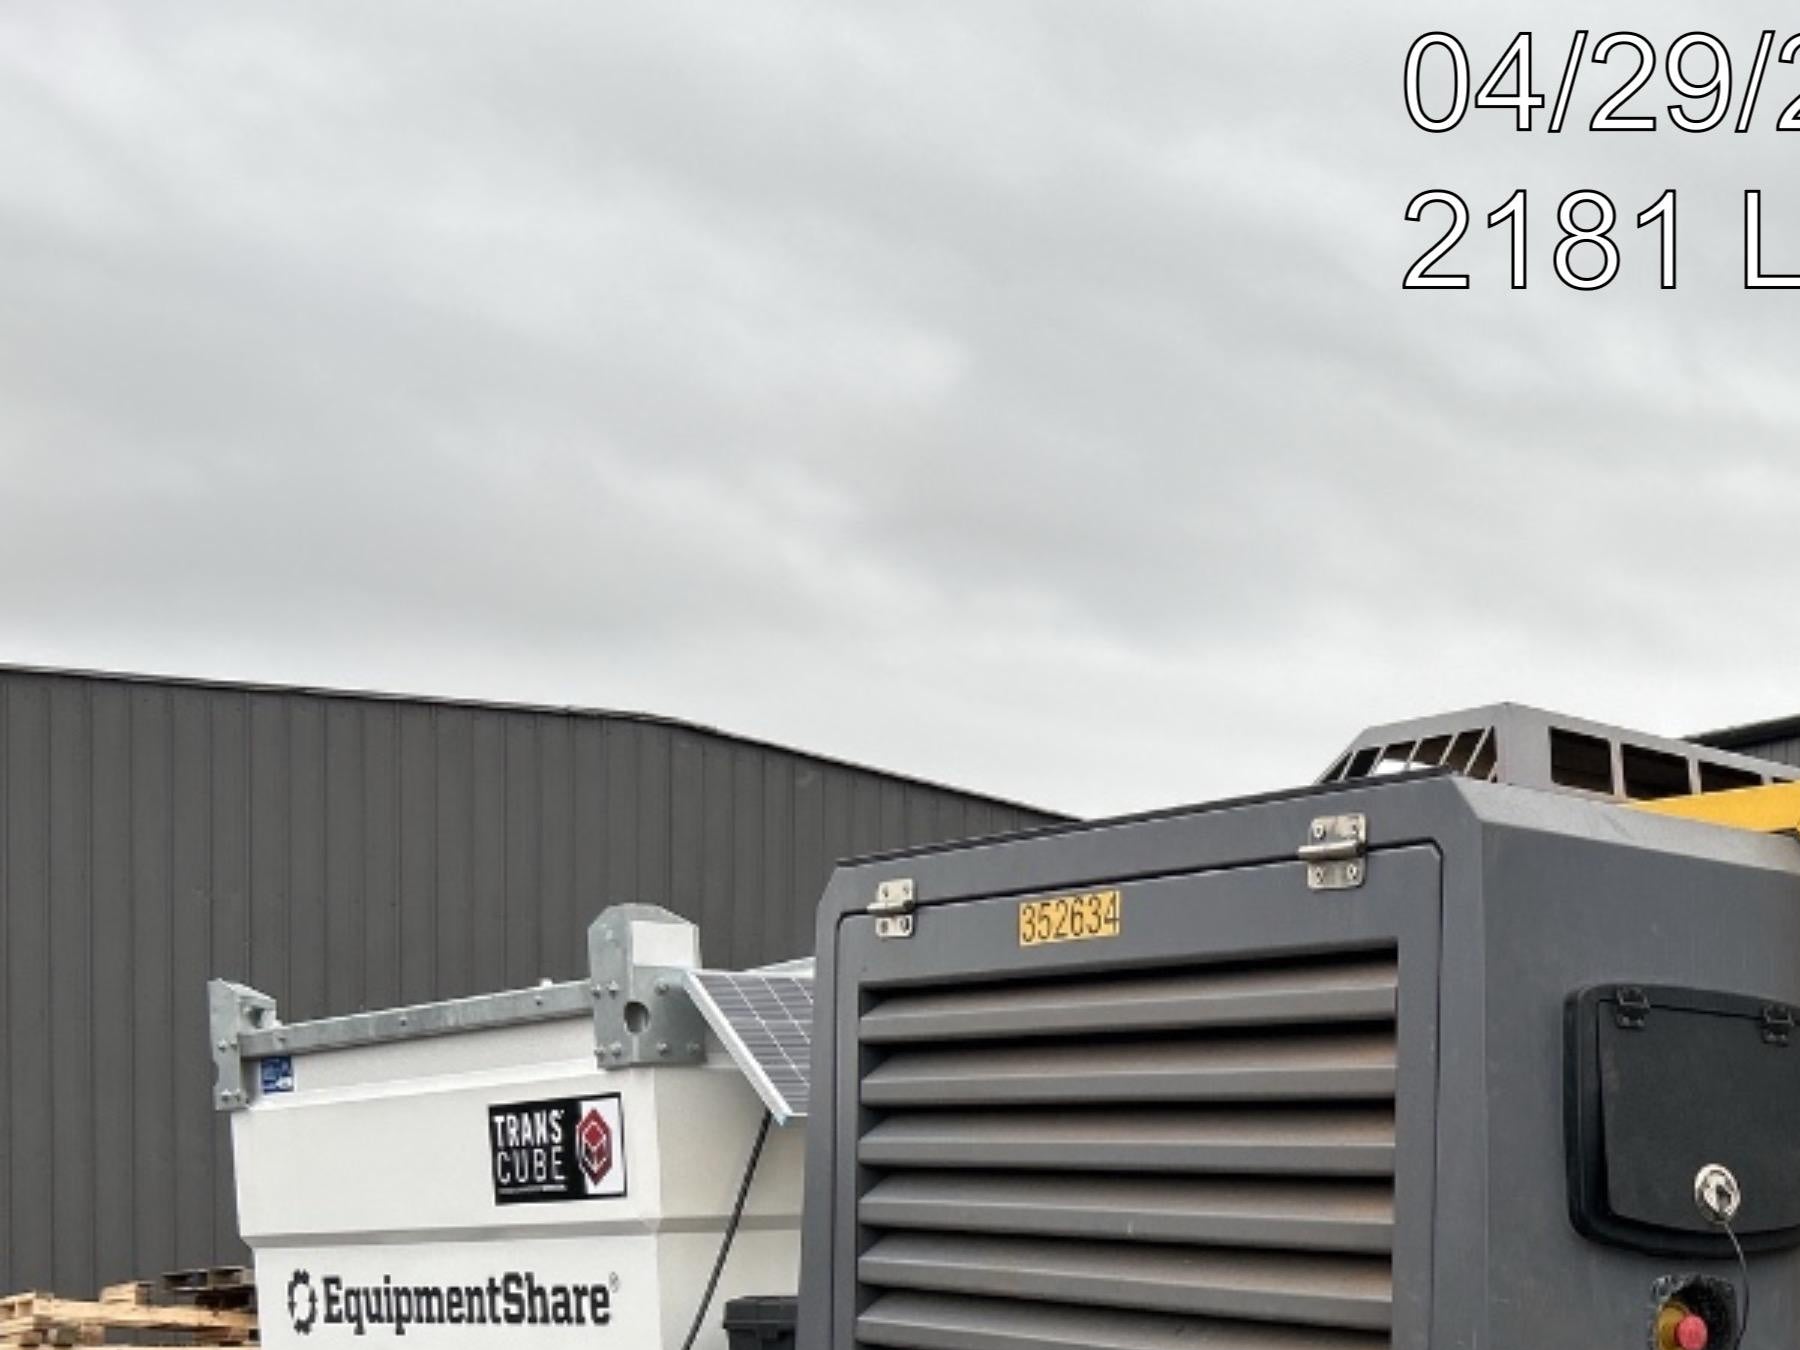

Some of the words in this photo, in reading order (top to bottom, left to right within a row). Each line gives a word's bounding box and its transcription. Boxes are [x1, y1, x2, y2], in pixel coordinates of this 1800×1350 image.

[1021, 890, 1120, 943] 352634
[493, 1108, 563, 1148] TRANS
[497, 1146, 567, 1185] CUBE
